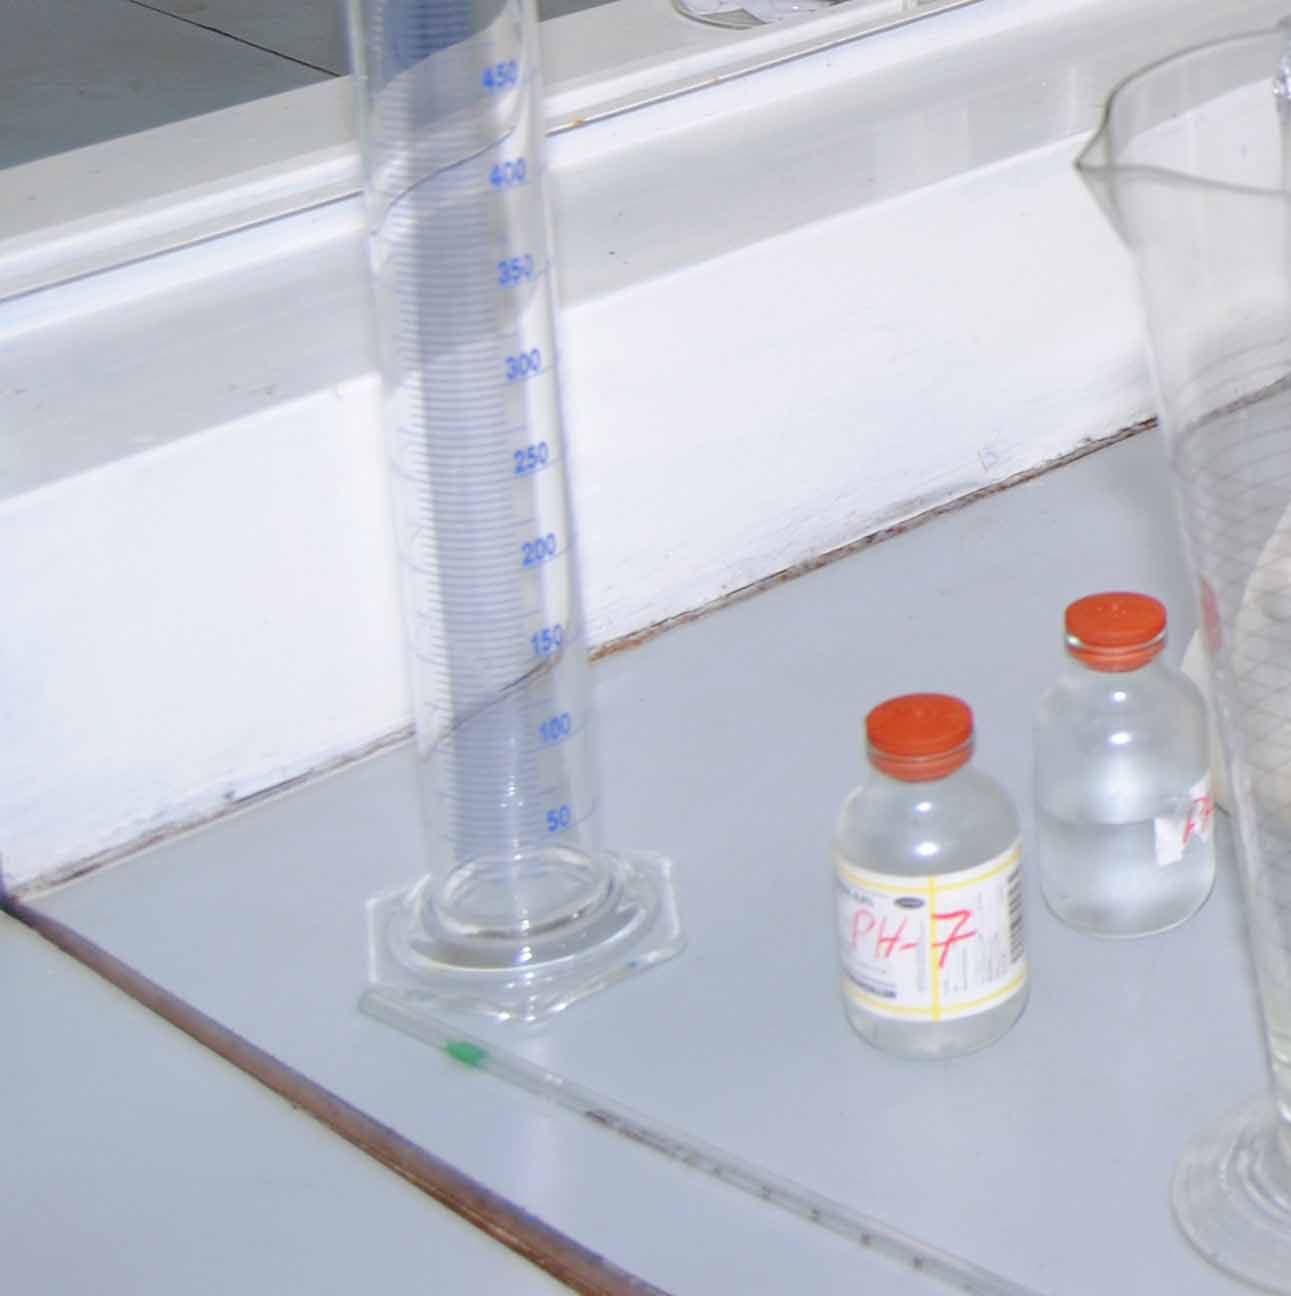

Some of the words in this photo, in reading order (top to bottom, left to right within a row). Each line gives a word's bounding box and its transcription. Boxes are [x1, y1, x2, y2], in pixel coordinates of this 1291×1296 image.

[499, 252, 534, 287] 350
[506, 347, 541, 382] 300
[513, 442, 549, 475] 250
[521, 533, 557, 568] 200
[530, 624, 564, 657] 150
[538, 713, 572, 744] 100
[546, 805, 571, 833] 50
